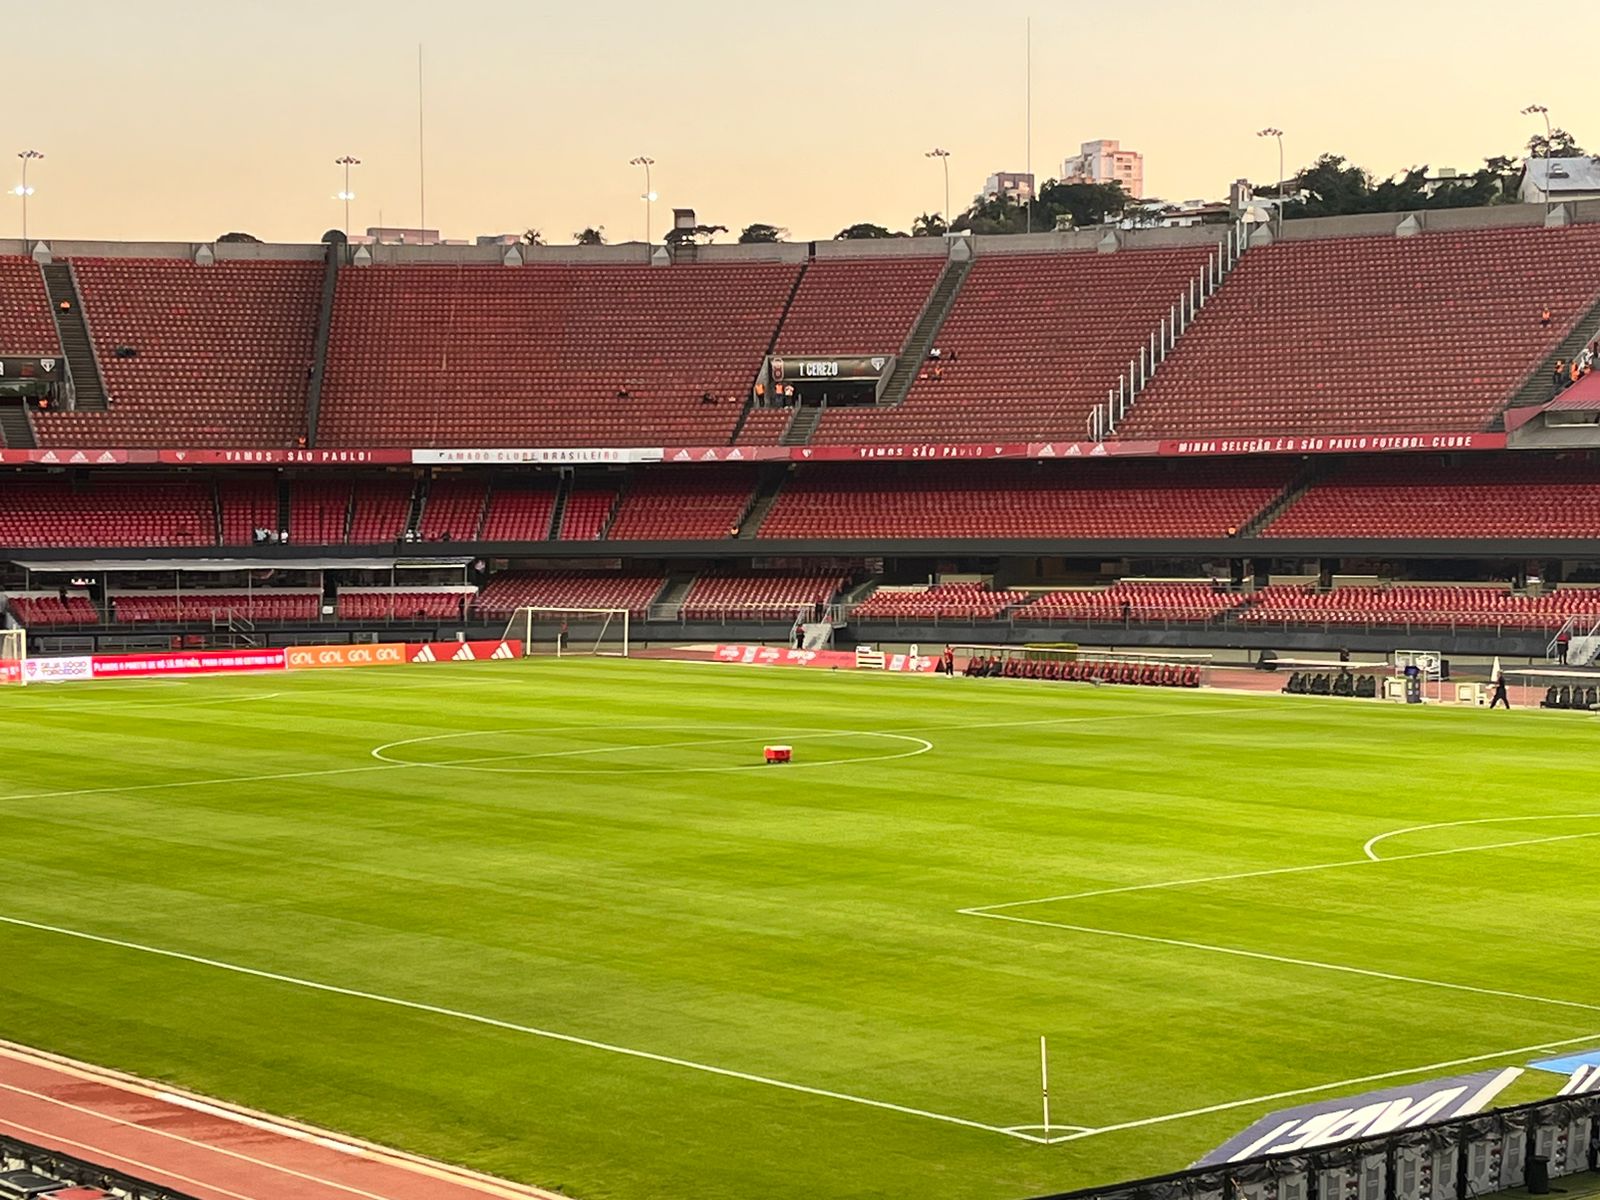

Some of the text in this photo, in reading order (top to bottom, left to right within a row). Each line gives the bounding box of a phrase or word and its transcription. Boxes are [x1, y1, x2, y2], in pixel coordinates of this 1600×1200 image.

[806, 361, 838, 376] CEREZO
[1178, 436, 1471, 452] MINHA SELEÇÃO É O SÃO PAULO FUTEBOL CLUBE
[287, 450, 313, 461] SÃO
[543, 451, 618, 460] BRASILEIRO
[860, 445, 982, 457] VAMOS SÃO PAULO
[290, 648, 400, 665] GOL GOL GOL GOL
